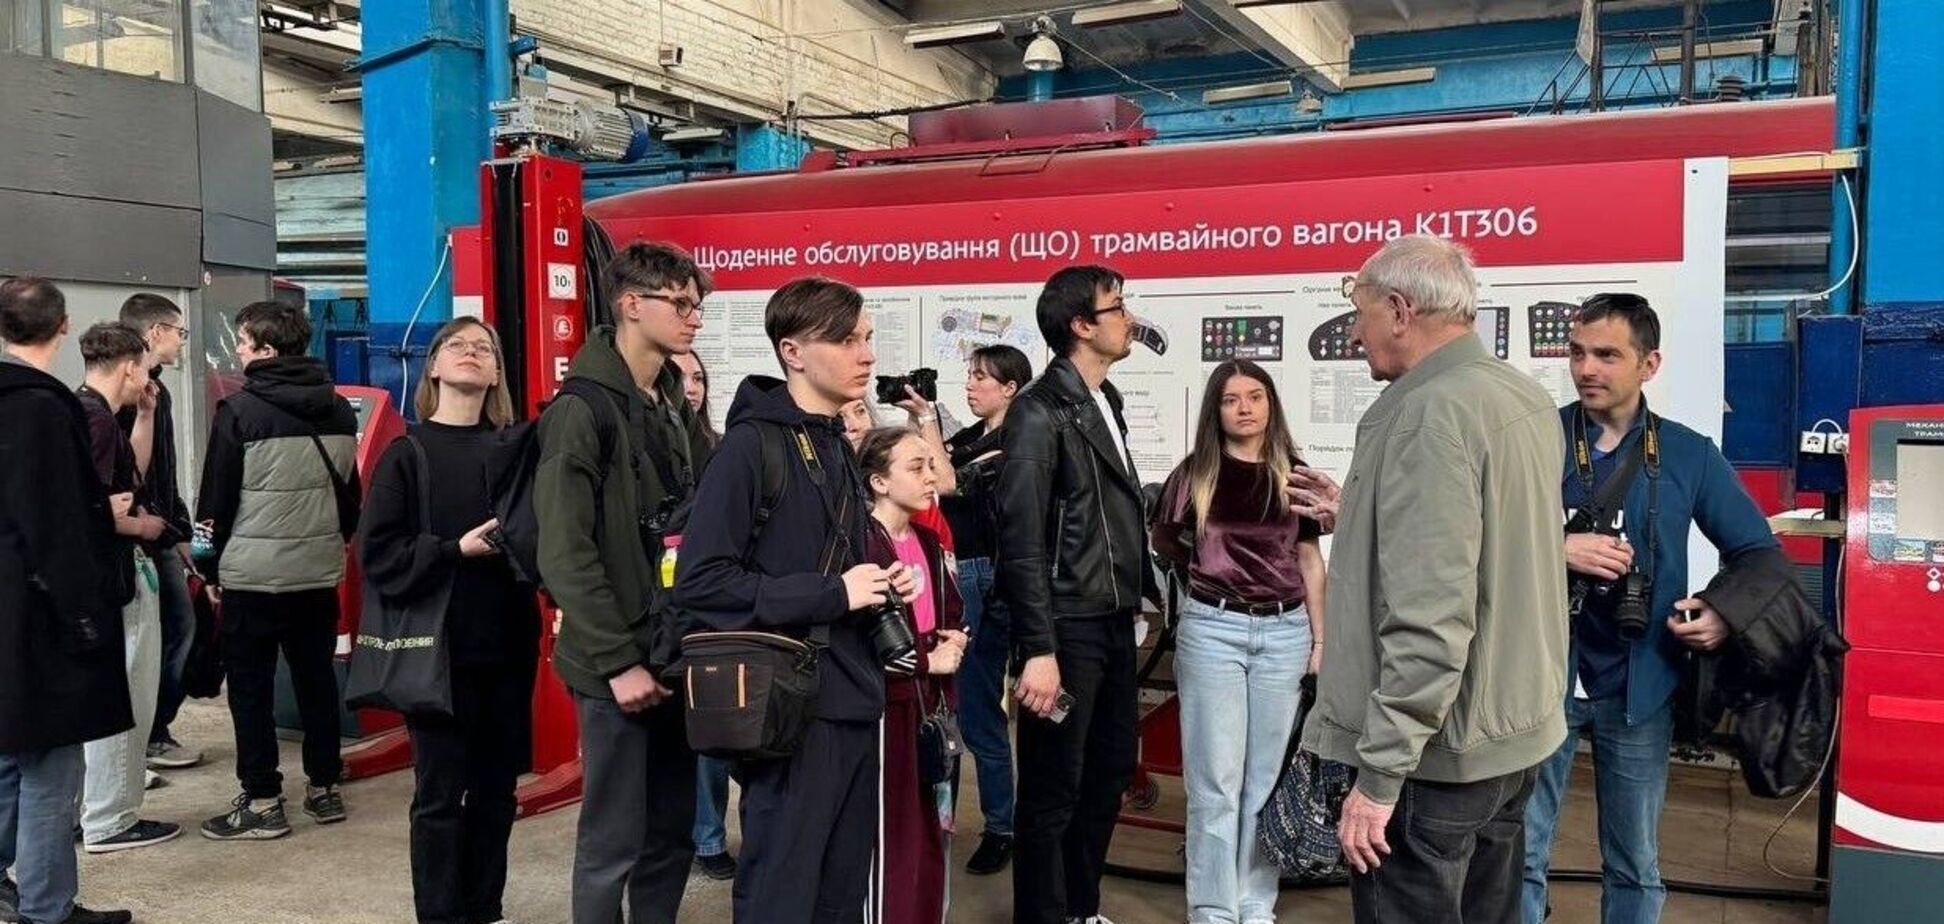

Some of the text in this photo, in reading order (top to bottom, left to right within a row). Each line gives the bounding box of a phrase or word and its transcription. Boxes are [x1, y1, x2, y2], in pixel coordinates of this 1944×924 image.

[694, 206, 1538, 272] Щоденне обслуговування (ЩО) трамвайного вагона К1Т306
